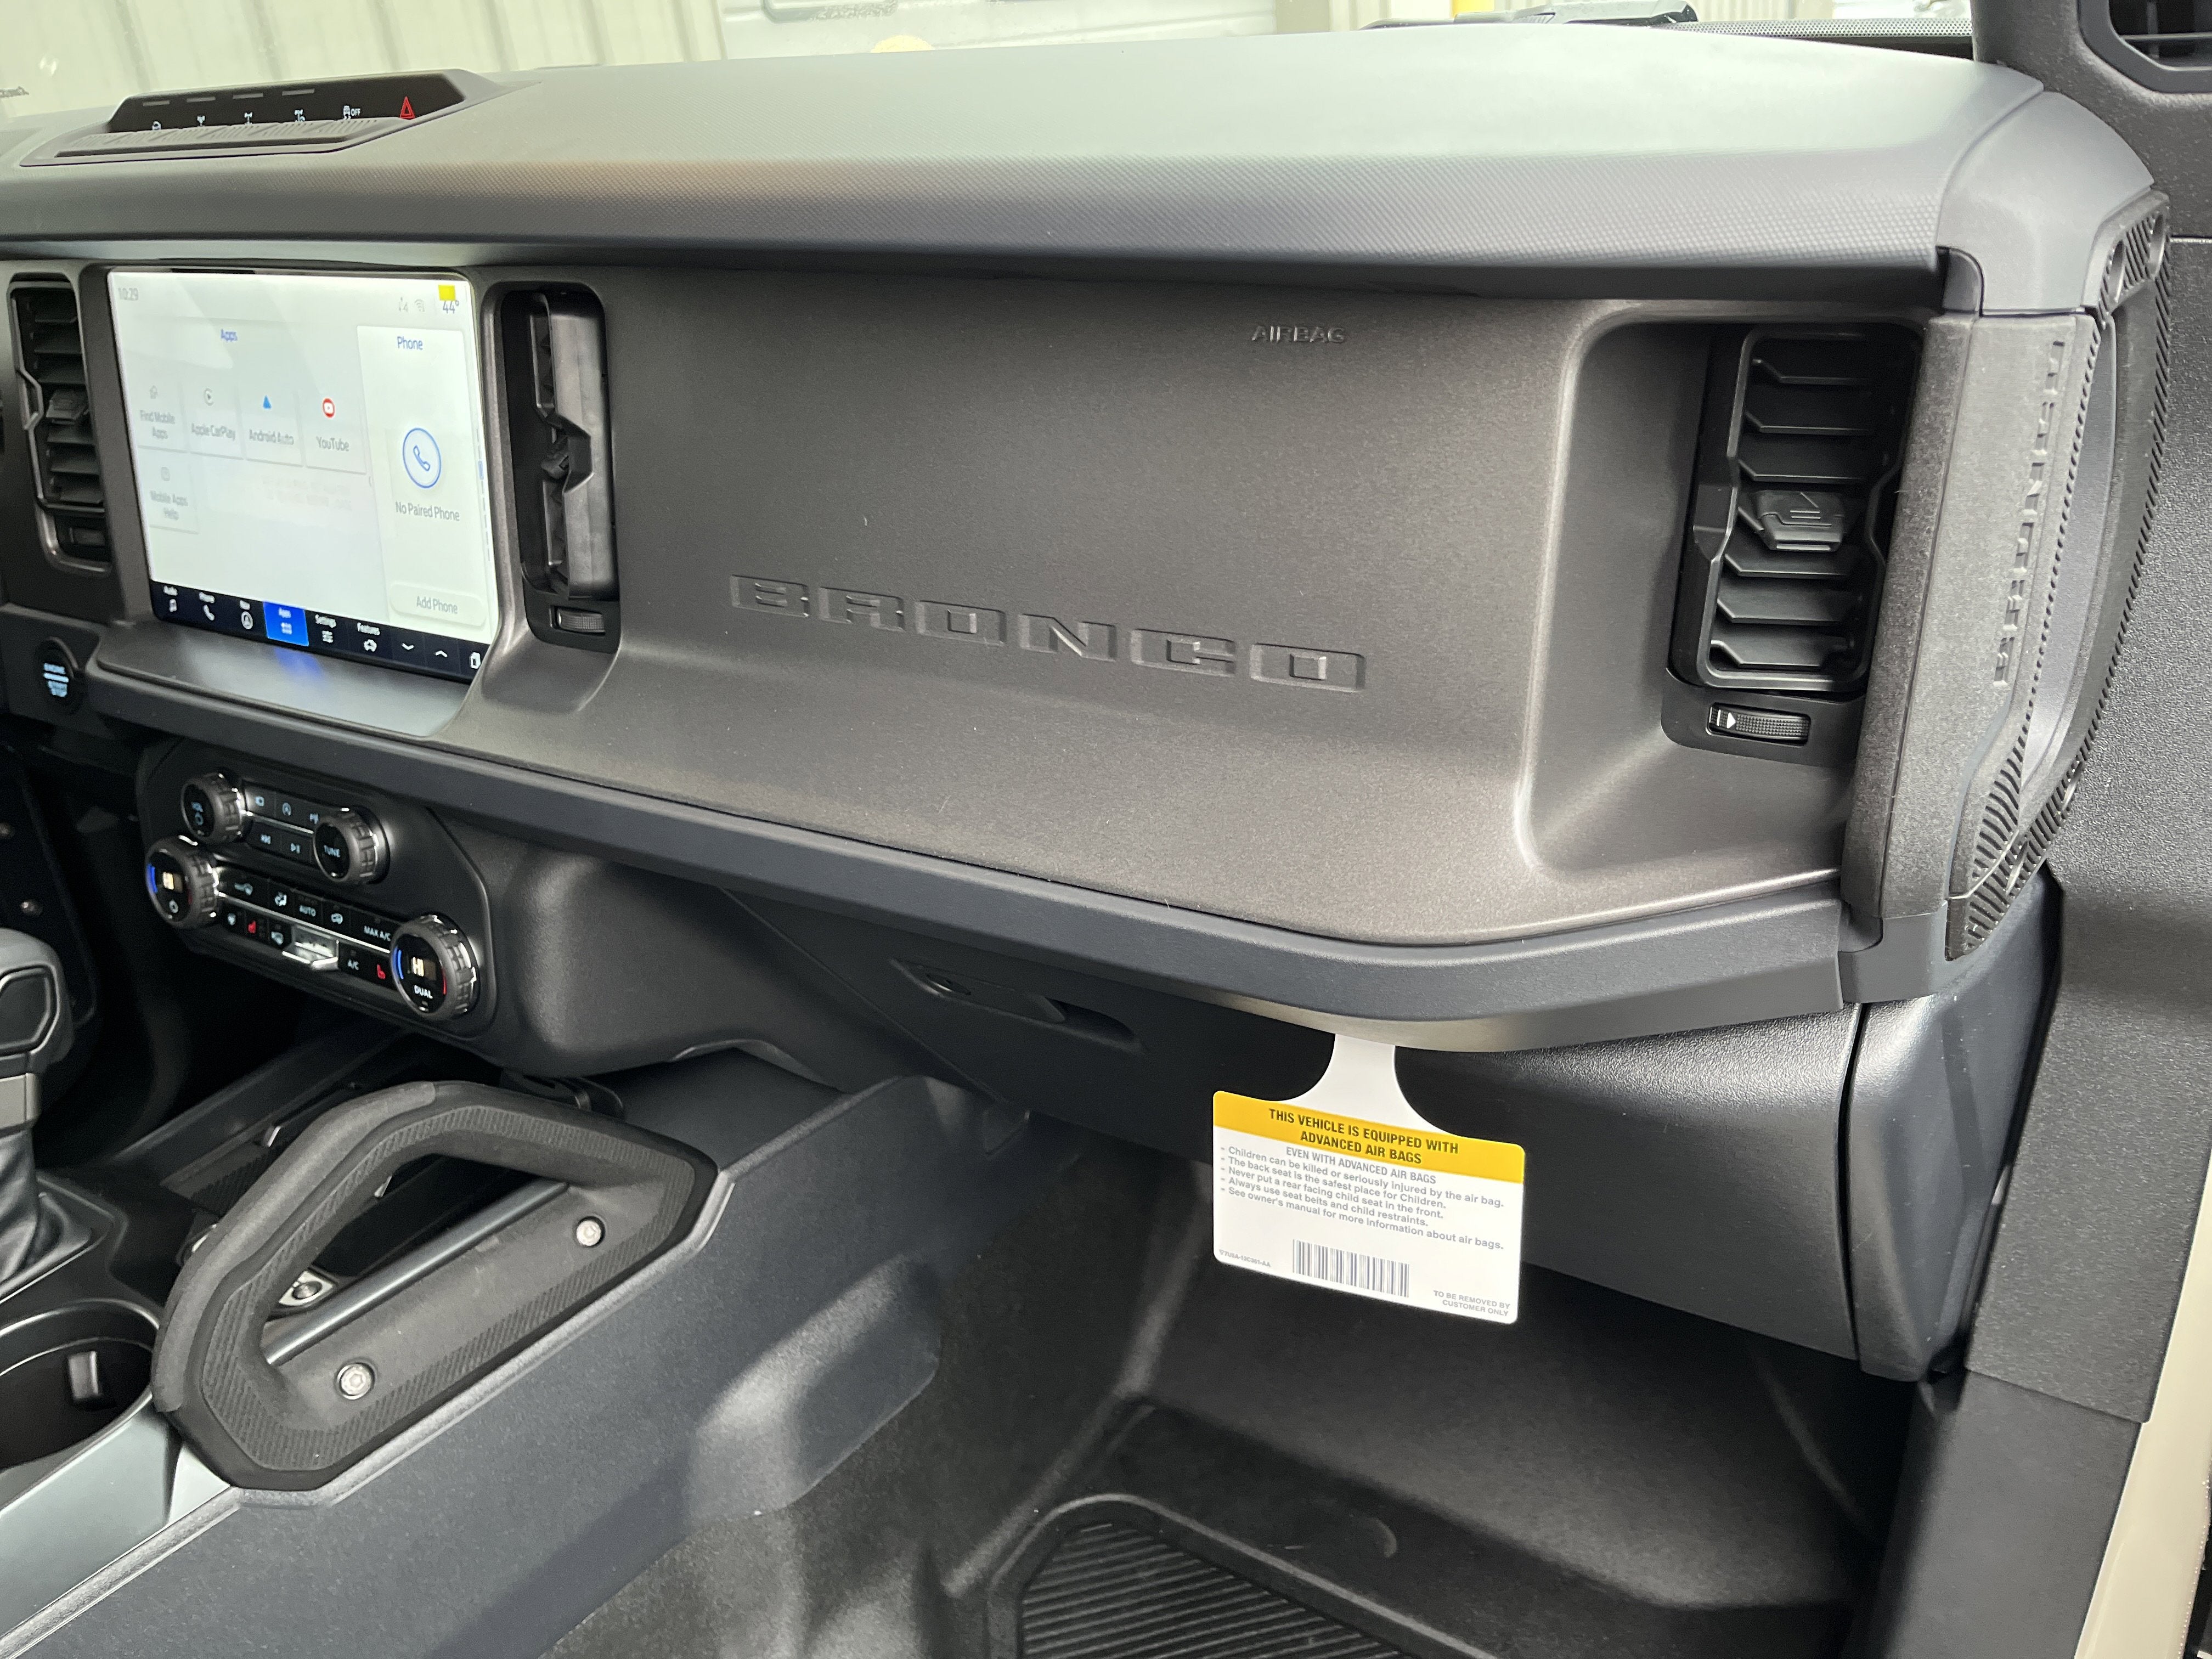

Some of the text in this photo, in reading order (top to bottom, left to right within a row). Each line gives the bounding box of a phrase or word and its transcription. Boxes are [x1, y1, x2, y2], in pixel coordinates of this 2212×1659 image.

[351, 108, 361, 116] OFF
[397, 336, 423, 350] Phone
[1251, 325, 1345, 343] AIRBAG
[316, 436, 349, 452] YouTube
[396, 501, 460, 521] No Paired Phone
[417, 596, 458, 614] Add Phone
[730, 574, 1366, 693] BRONCO
[324, 845, 341, 858] TUNE
[299, 904, 316, 917] AUTO
[364, 925, 391, 942] MAX A/C
[348, 959, 359, 971] A/C
[414, 985, 433, 1000] DUAL
[1269, 1108, 1458, 1154] THIS VEHICLE IS EQUIPPED WITH
[1300, 1131, 1421, 1164] ADVANCED AIR BAGS
[1286, 1147, 1436, 1184] EVEN WITH ADVANCED AIR BAGS
[1228, 1156, 1245, 1167] The
[1248, 1160, 1269, 1173] back
[1272, 1167, 1291, 1177] seat
[1294, 1170, 1301, 1180] is
[1305, 1173, 1319, 1184] the
[1323, 1177, 1351, 1191] safest
[1354, 1186, 1380, 1197] place
[1383, 1190, 1397, 1200] for
[1400, 1193, 1446, 1209] Children.
[1229, 1146, 1266, 1161] Children
[1269, 1156, 1286, 1166] can
[1289, 1160, 1300, 1169] be
[1303, 1161, 1328, 1175] killed
[1331, 1169, 1341, 1178] or
[1344, 1172, 1388, 1189] seriously
[1392, 1181, 1426, 1195] injured
[1430, 1188, 1442, 1199] by
[1446, 1190, 1462, 1200] the
[1464, 1194, 1478, 1203] air
[1481, 1196, 1504, 1208] bag.
[1228, 1166, 1255, 1180] Never
[1257, 1174, 1272, 1184] put
[1283, 1180, 1301, 1190] rear
[1304, 1183, 1333, 1199] facing
[1335, 1190, 1359, 1202] child
[1362, 1198, 1383, 1208] seat
[1385, 1201, 1394, 1209] in
[1397, 1203, 1413, 1213] the
[1416, 1207, 1443, 1219] front.
[1228, 1177, 1261, 1191] Always
[1263, 1186, 1280, 1195] use
[1283, 1189, 1302, 1201] seat
[1305, 1193, 1328, 1207] belts
[1330, 1200, 1348, 1211] and
[1351, 1204, 1375, 1216] child
[1378, 1210, 1428, 1226] restraints.
[1228, 1187, 1245, 1197] See
[1248, 1192, 1283, 1206] owner's
[1286, 1201, 1320, 1215] manual
[1323, 1208, 1336, 1218] for
[1339, 1213, 1364, 1224] more
[1367, 1217, 1424, 1236] information
[1426, 1231, 1456, 1242] about
[1459, 1235, 1472, 1244] air
[1475, 1237, 1504, 1250] bags.
[1442, 1300, 1509, 1316] CUSTOMER ONLY
[1459, 1295, 1497, 1307] REMOVED
